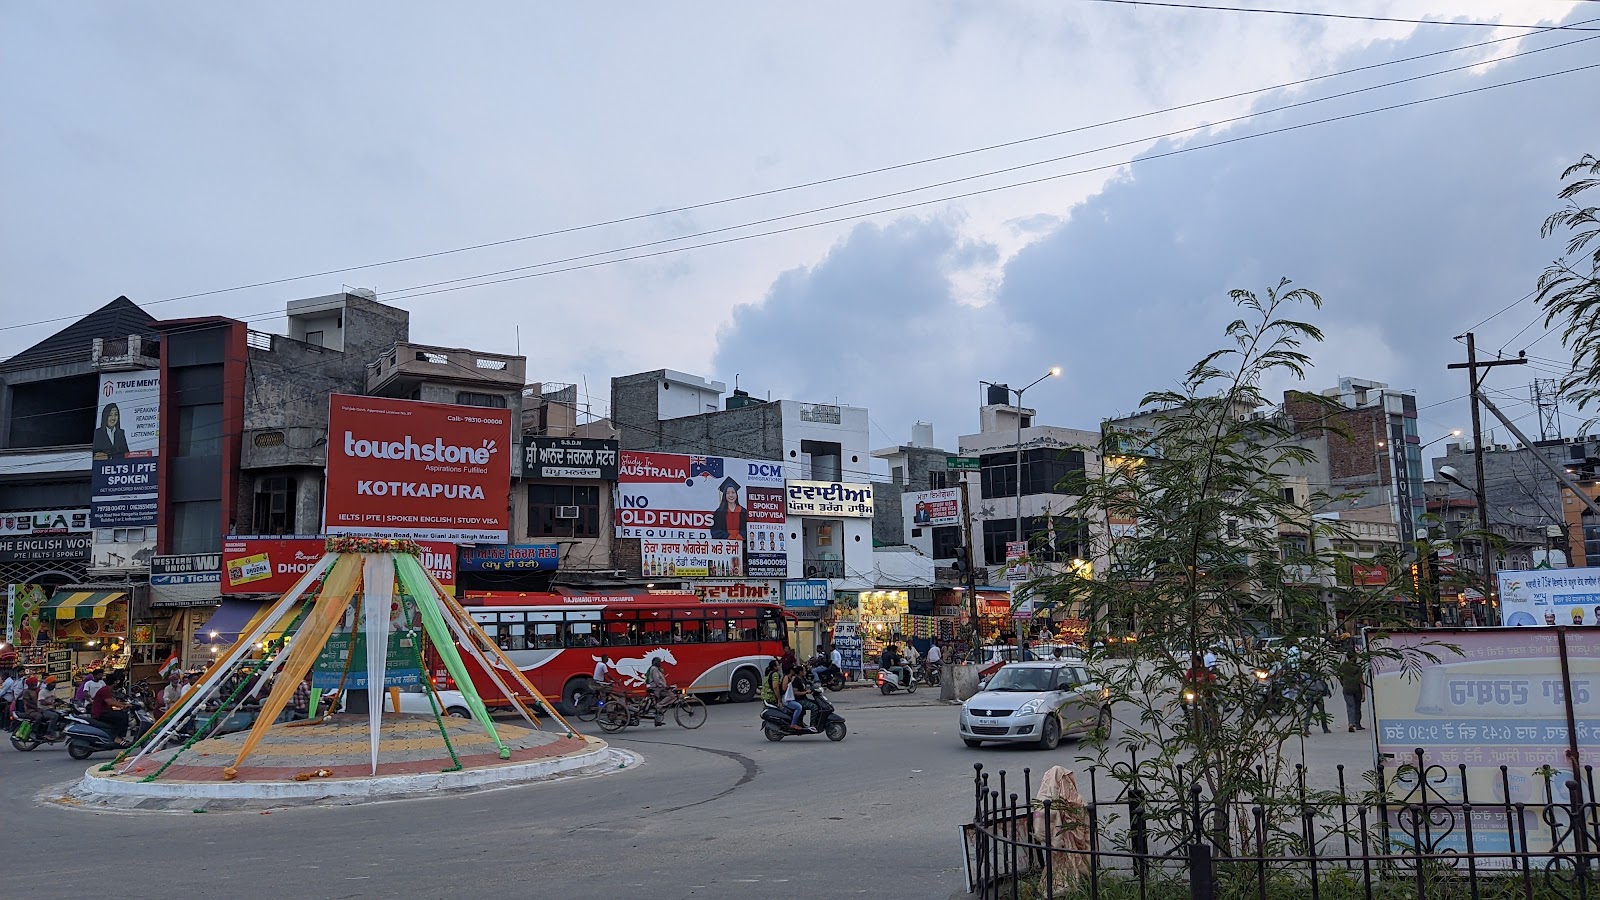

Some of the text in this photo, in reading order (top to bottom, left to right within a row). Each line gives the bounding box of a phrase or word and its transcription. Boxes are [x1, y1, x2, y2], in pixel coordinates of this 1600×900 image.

[117, 379, 160, 389] TRUE MENT
[344, 431, 490, 465] touchstone
[539, 442, 565, 464] ਆਨੰਦ
[621, 454, 653, 467] Study In
[102, 463, 157, 474] IELTS PTE
[424, 464, 488, 474] Aspirations Fulfilled
[619, 465, 687, 479] AUSTRALIA
[748, 463, 782, 477] DCM
[108, 474, 149, 485] SPOKEN
[357, 480, 486, 500] KOTKAPURA
[788, 483, 871, 503] ਦਵਾਈਆਂ
[623, 495, 649, 509] NO
[749, 493, 765, 501] IELTS
[788, 500, 814, 511] ਪੰਜਾਬ
[339, 513, 360, 521] IELTS
[366, 514, 381, 522] PTE
[386, 515, 418, 523] SPOKEN
[621, 510, 715, 527] OLD FUNDS
[748, 510, 768, 518] STUDY
[770, 511, 784, 519] VISA
[623, 528, 707, 539] REQUIRED
[0, 538, 93, 551] HE ENGLISH WOR
[644, 540, 659, 554] ਠੇਕਾ
[711, 541, 723, 555] ਅਤੇ
[725, 541, 739, 555] ਦੇਸੀ
[32, 551, 49, 559] IELTS
[477, 546, 505, 560] ਆਨੰਦ
[153, 556, 221, 571] WESTERN WU
[165, 564, 193, 572] UNION
[504, 559, 514, 568] ਦੀ
[170, 574, 222, 584] Air Ticket
[432, 570, 452, 580] EETS
[785, 584, 827, 600] MEDICINES
